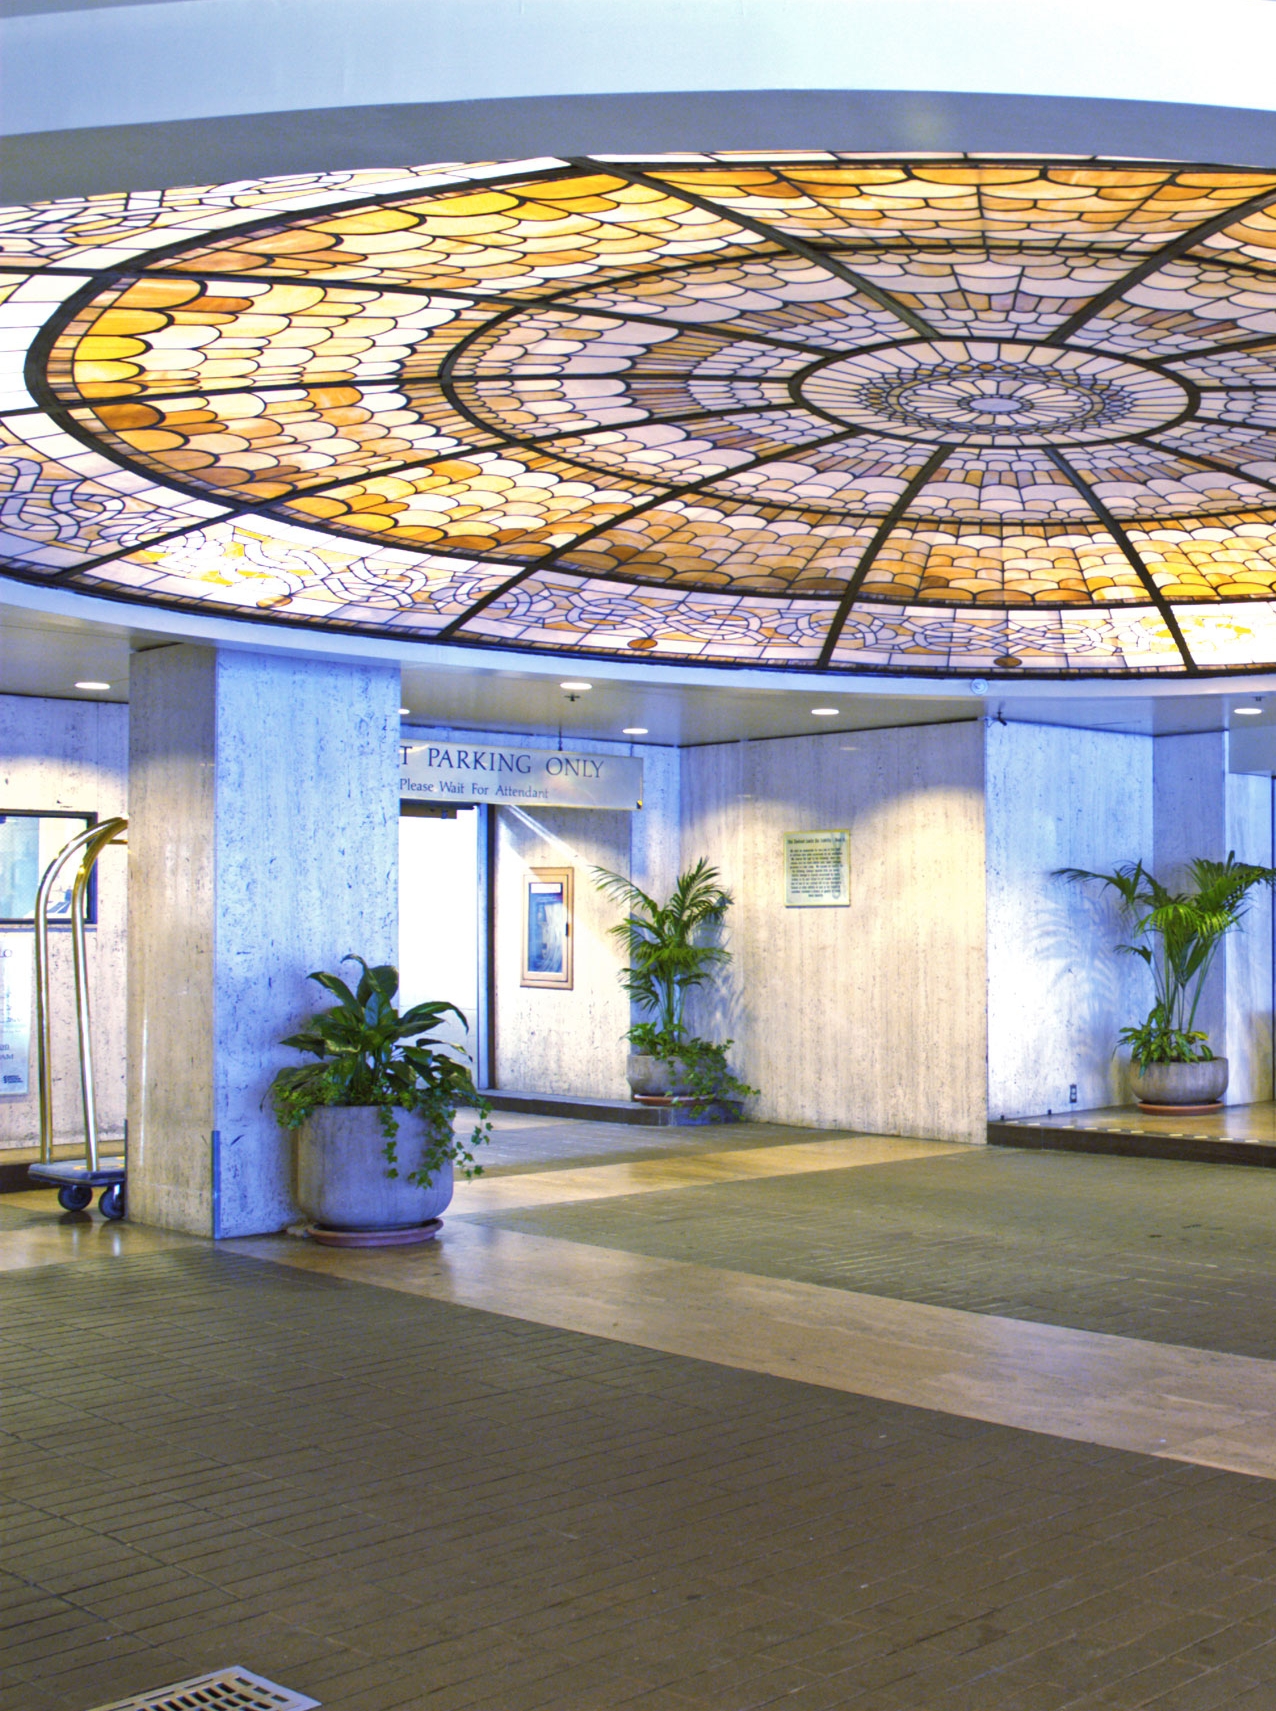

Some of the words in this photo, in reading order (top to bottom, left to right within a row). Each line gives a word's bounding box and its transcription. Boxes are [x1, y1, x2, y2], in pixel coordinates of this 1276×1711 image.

[428, 747, 531, 774] PARKING
[545, 756, 604, 778] ONLY
[399, 778, 434, 792] Please
[439, 780, 464, 794] Wait
[471, 783, 489, 796] For
[495, 785, 549, 799] Attendant
